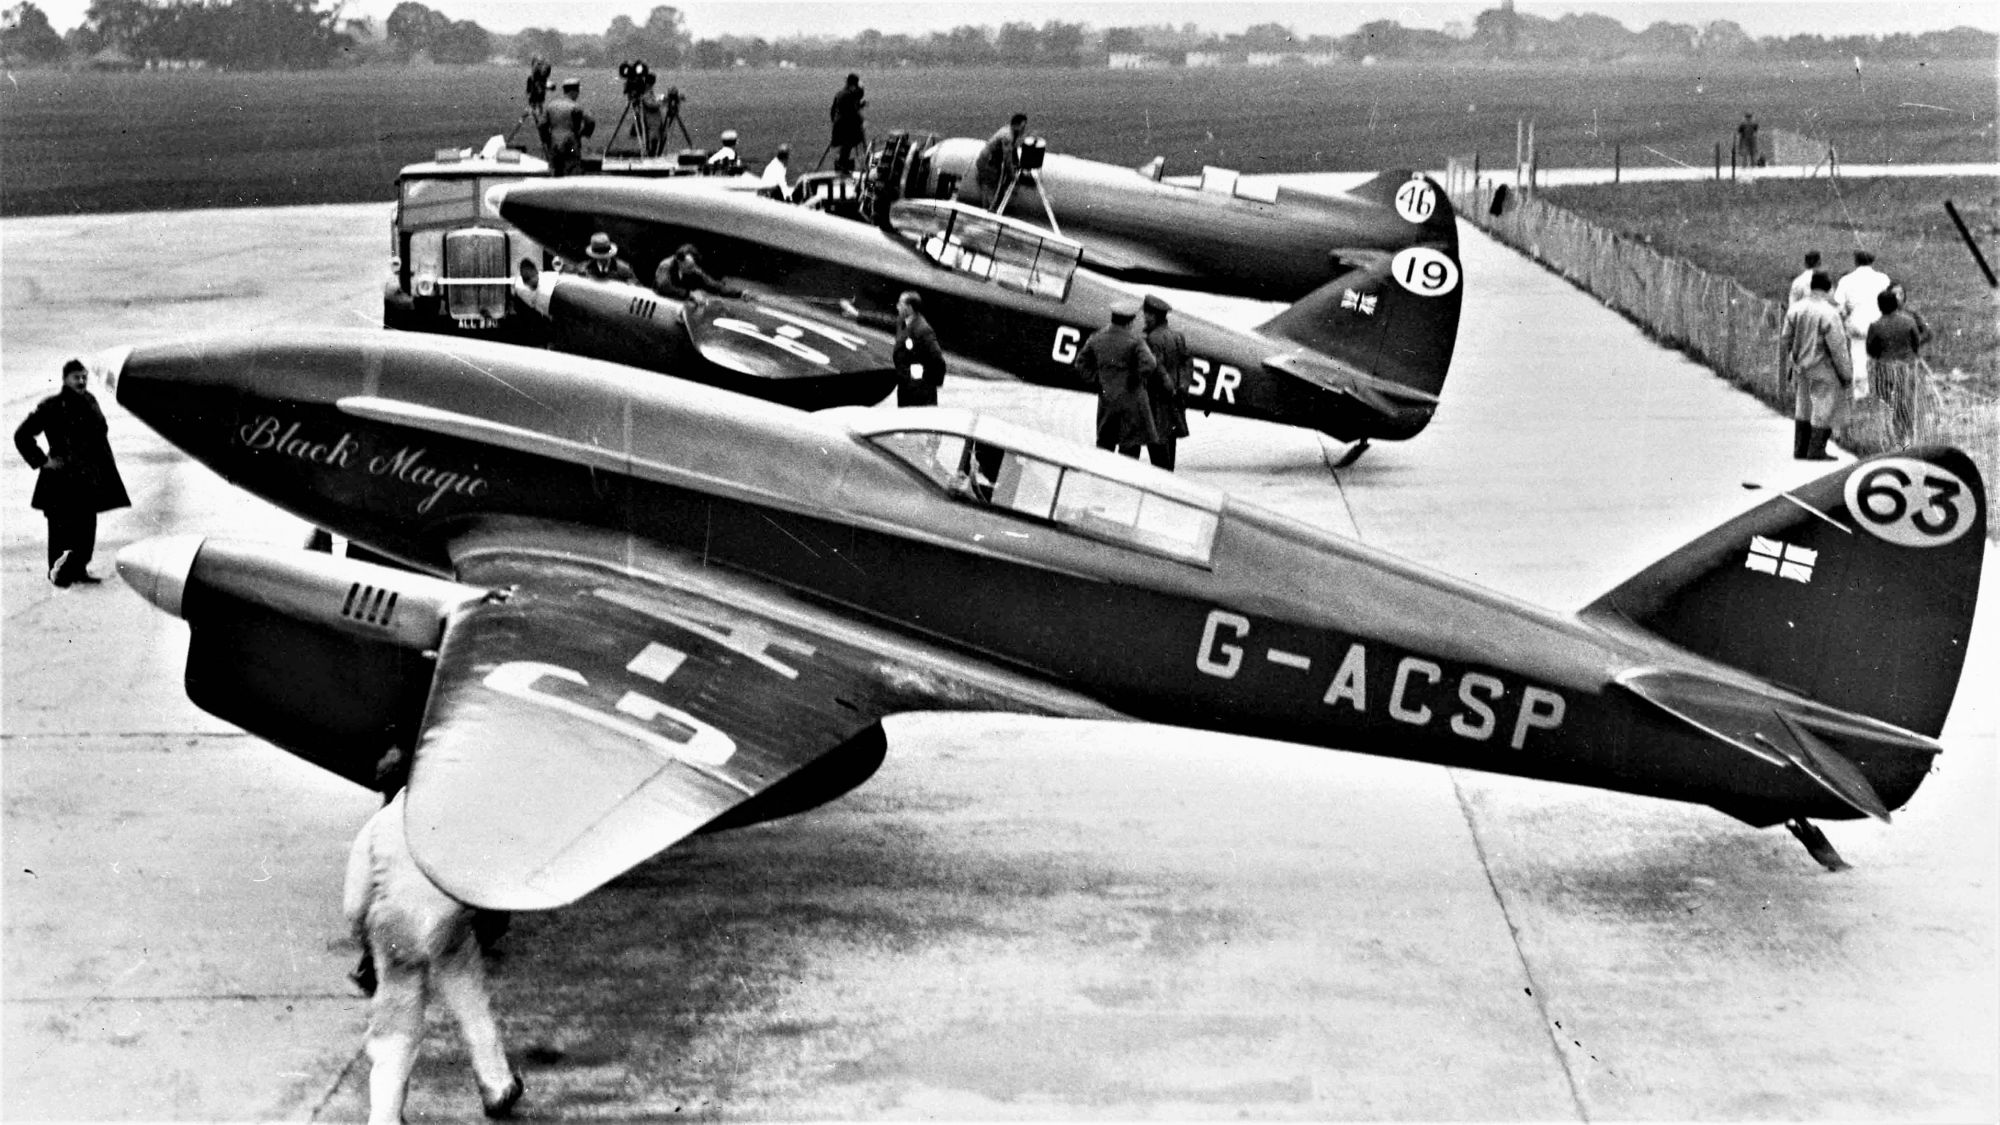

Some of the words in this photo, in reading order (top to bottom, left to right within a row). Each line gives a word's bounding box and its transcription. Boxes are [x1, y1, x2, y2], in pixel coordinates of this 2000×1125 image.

[1399, 185, 1431, 216] 46
[1405, 256, 1448, 290] 19
[240, 416, 359, 468] Black
[369, 447, 488, 515] Magic
[1857, 466, 1961, 537] 63
[1196, 609, 1566, 751] G-ACSP
